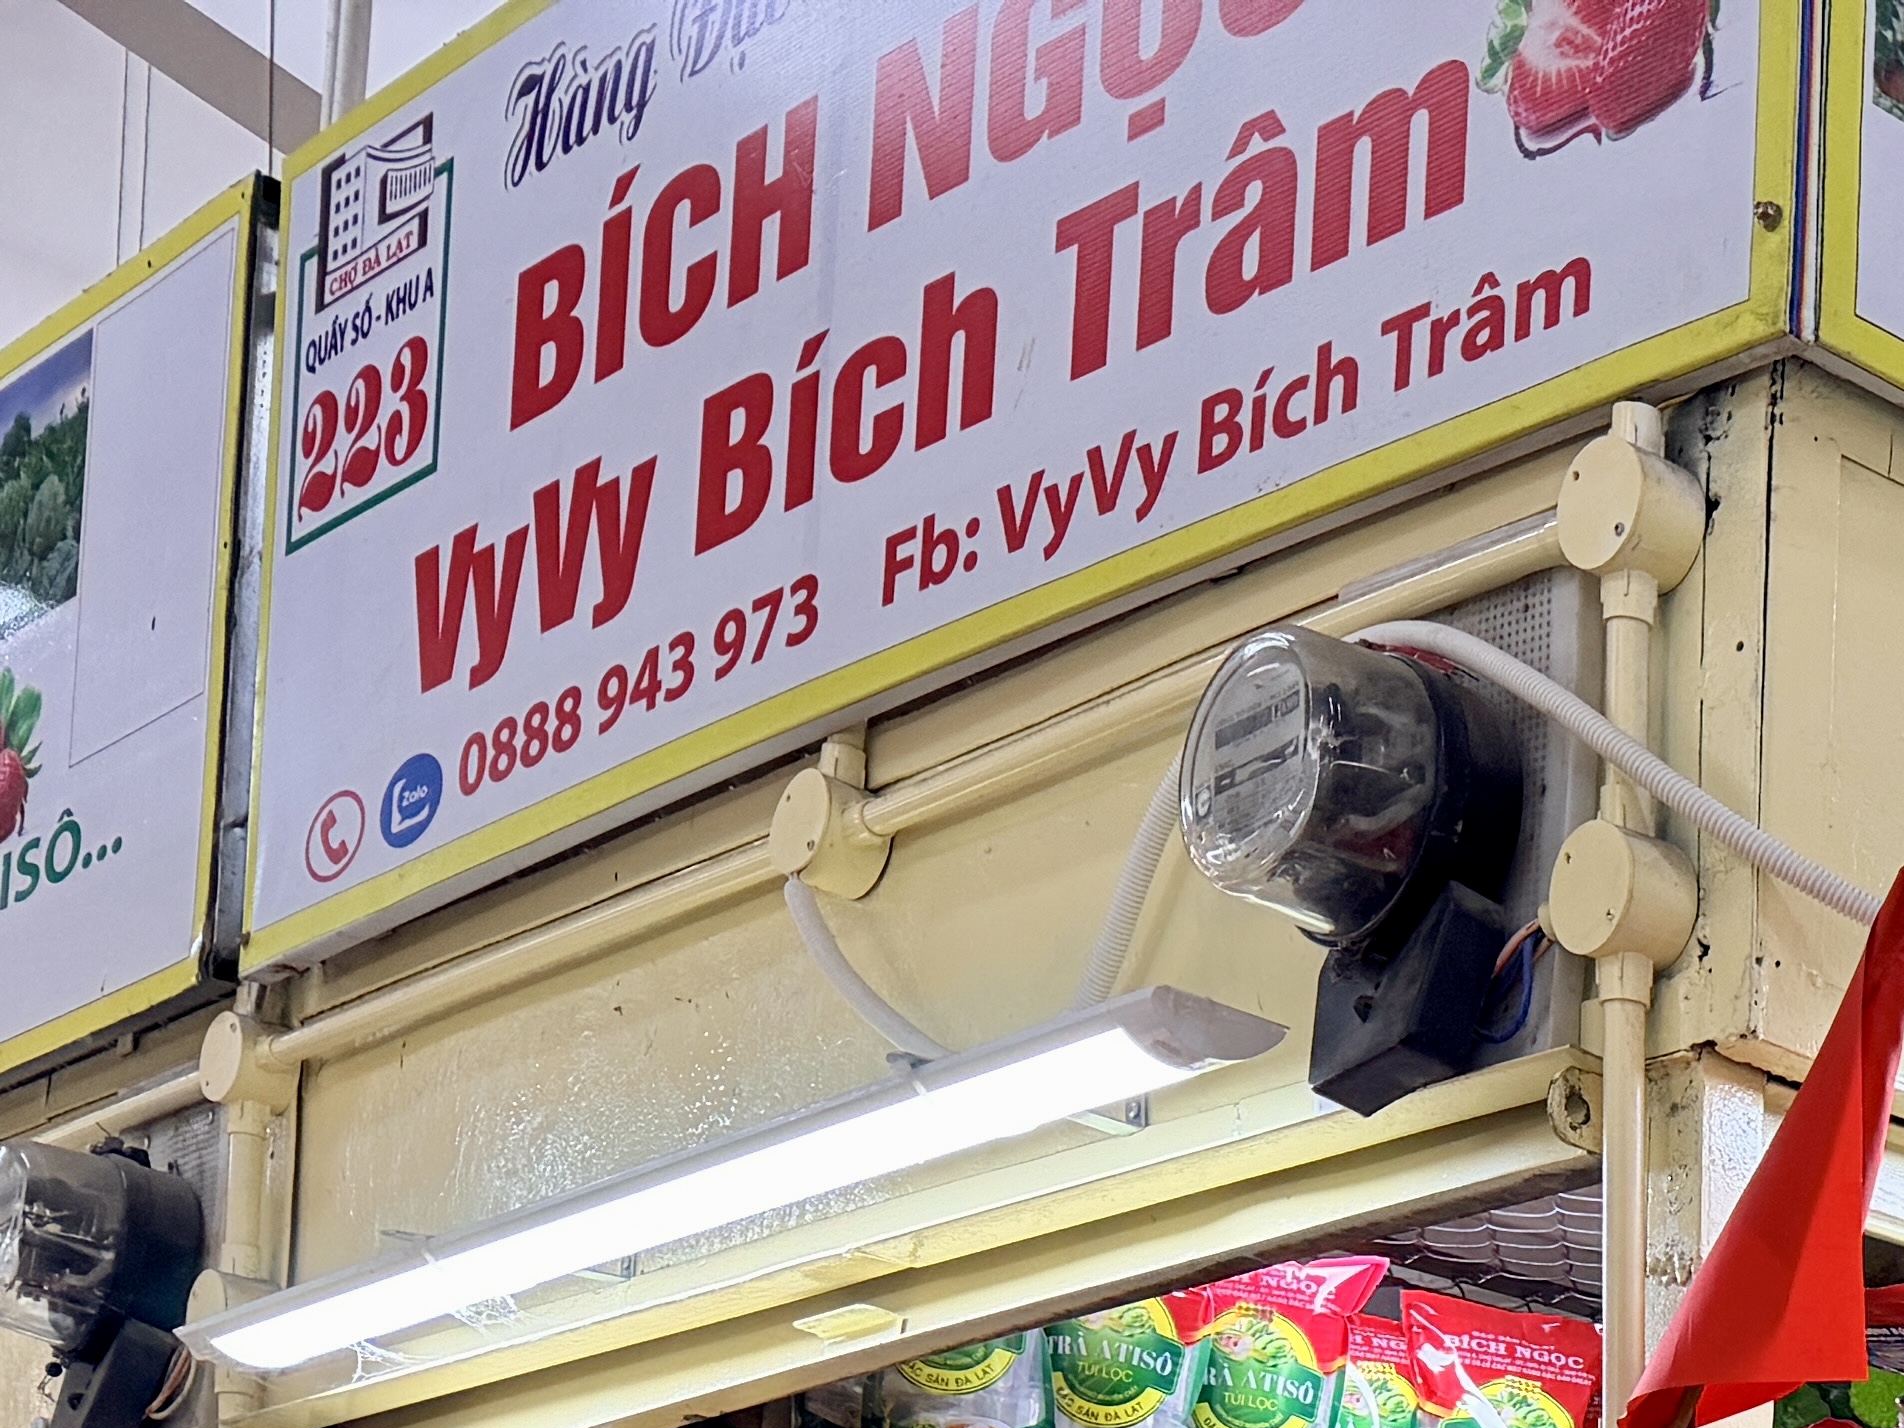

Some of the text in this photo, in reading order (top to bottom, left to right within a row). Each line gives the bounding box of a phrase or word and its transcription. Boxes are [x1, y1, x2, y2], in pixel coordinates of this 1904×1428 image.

[505, 22, 658, 190] Hàng
[510, 0, 1302, 431] BÍCH NGỌ
[351, 292, 373, 347] SỐ
[385, 274, 420, 327] KHU
[423, 267, 434, 303] A
[298, 336, 428, 522] 223
[412, 59, 1470, 694] VyVy Bích Trâm
[458, 256, 1592, 797] 0888 943 973 Fb: VyVy Bích Trâm
[0, 808, 122, 910] ISÔ...
[400, 785, 430, 807] Zalo
[1101, 1339, 1172, 1376] ATISÔ
[1515, 1344, 1584, 1370] NGỌC
